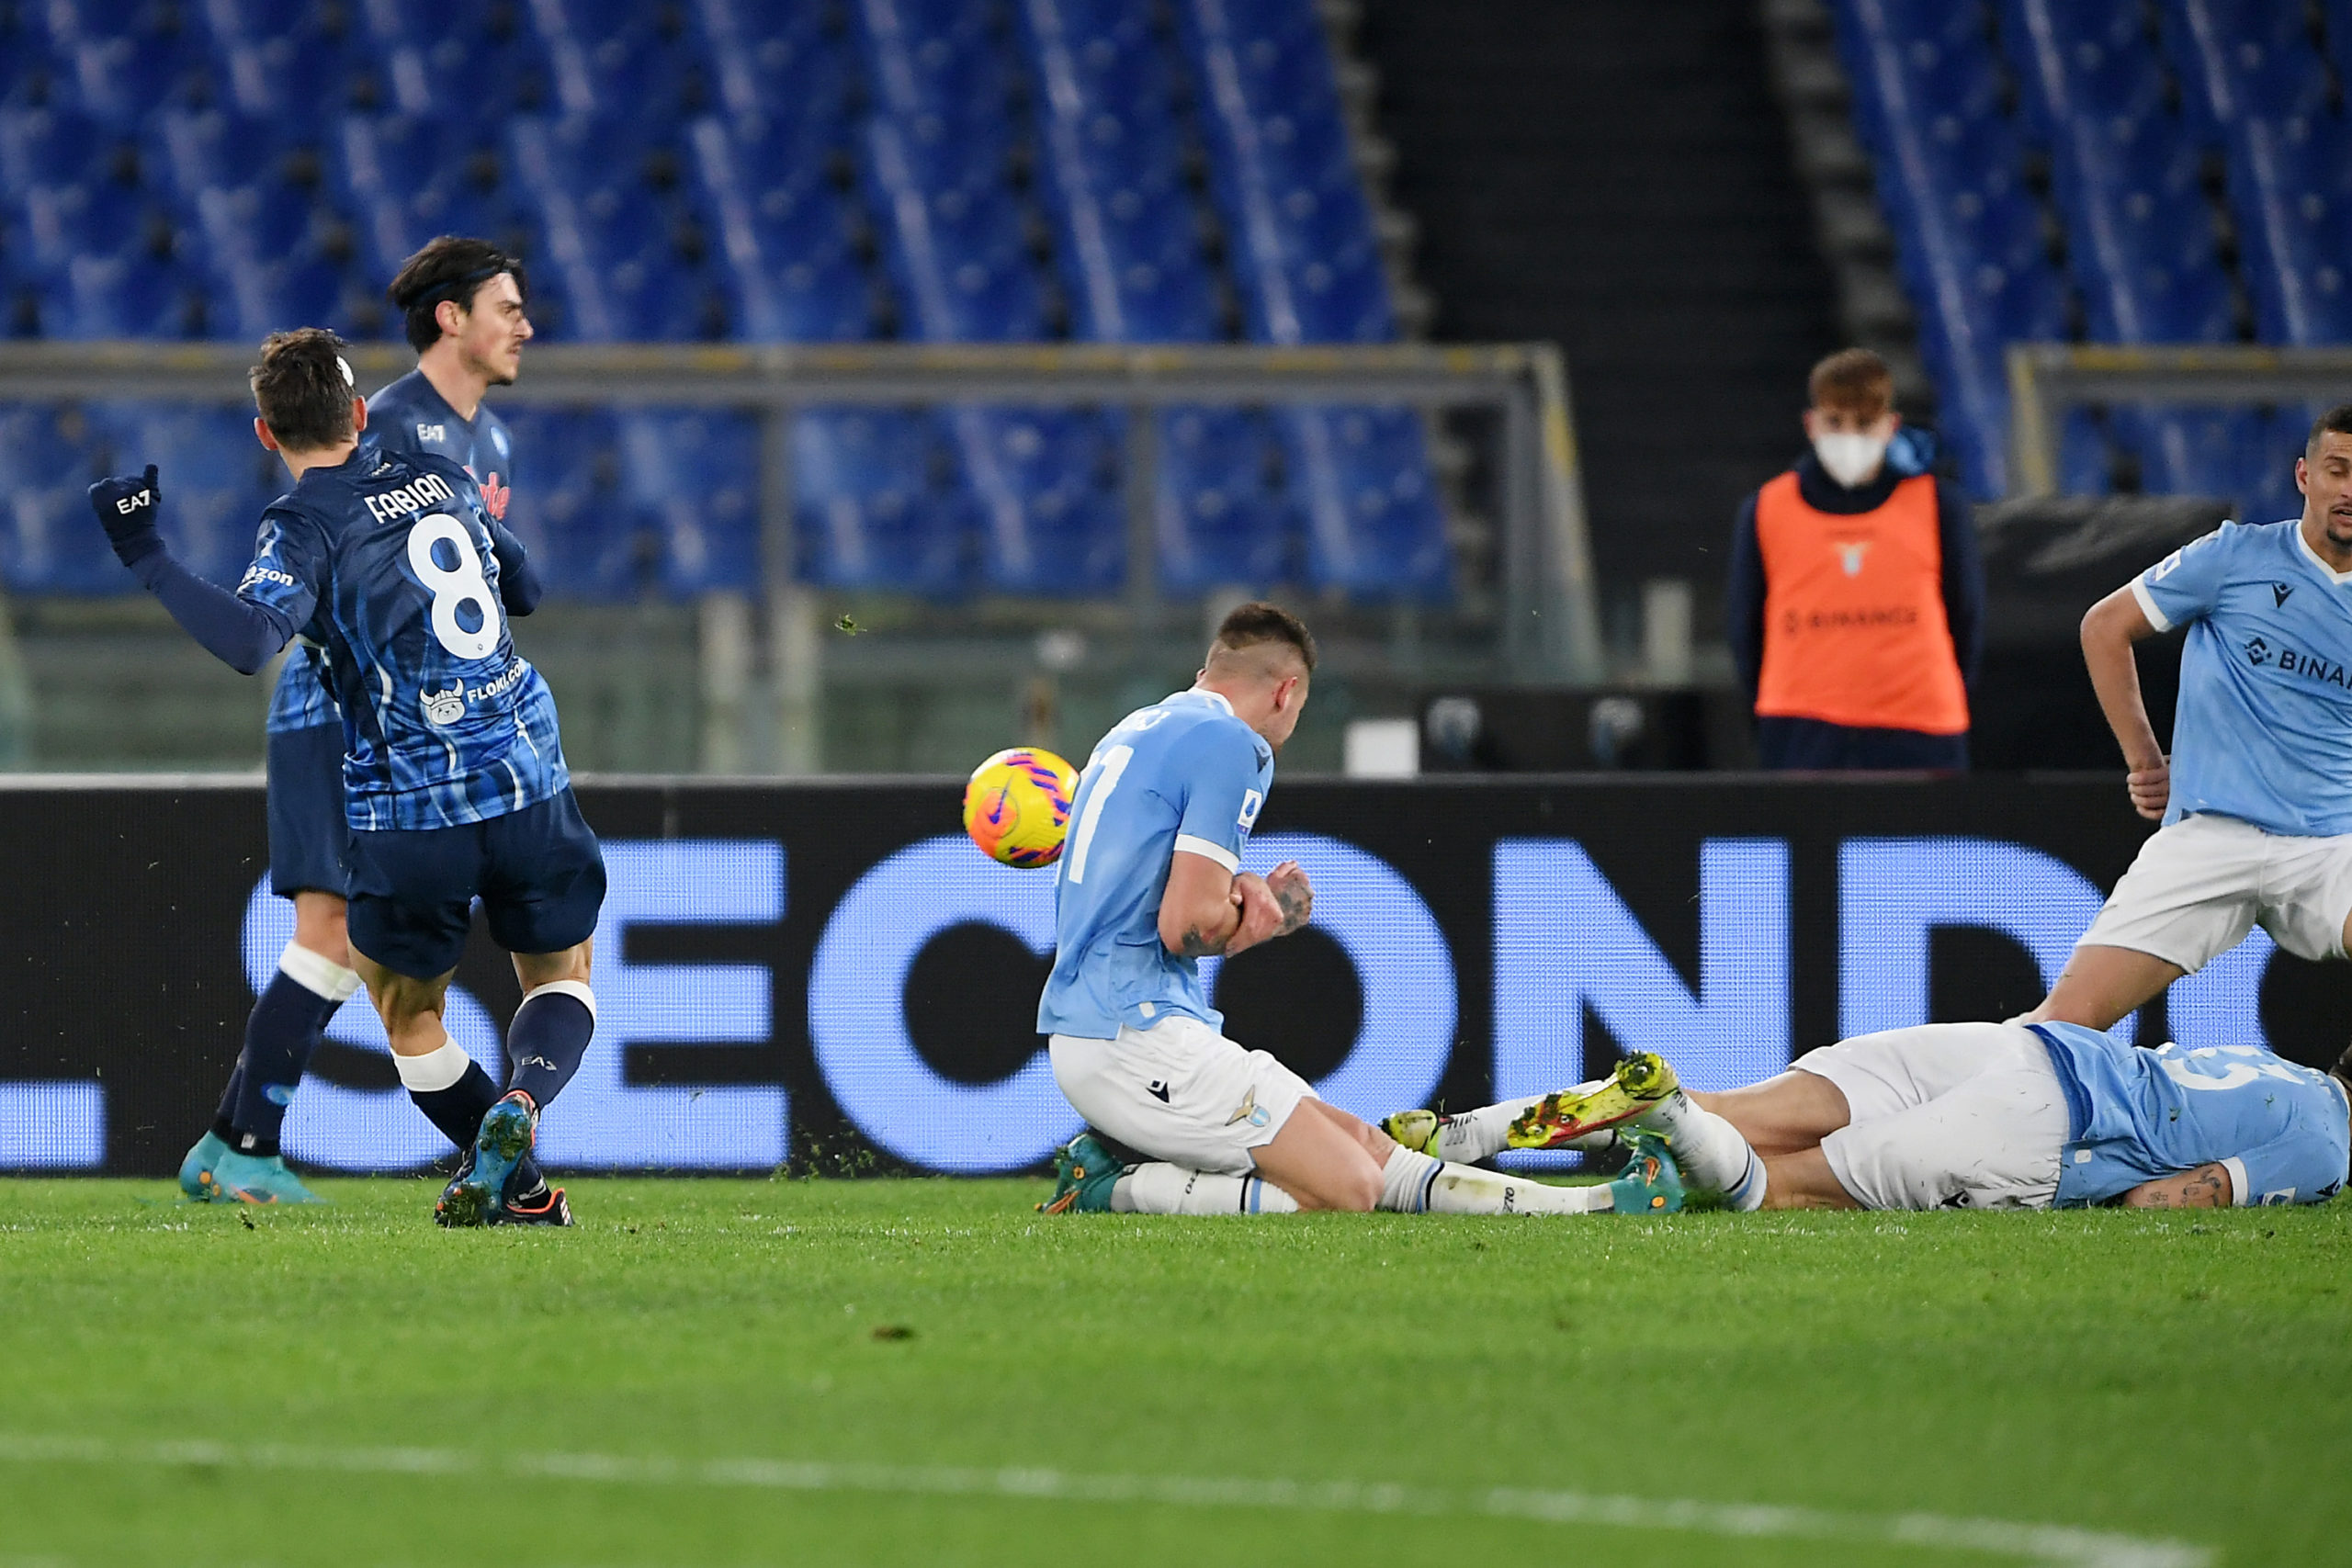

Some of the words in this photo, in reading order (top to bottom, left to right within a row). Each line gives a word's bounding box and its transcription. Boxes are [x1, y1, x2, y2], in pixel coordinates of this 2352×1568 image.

[116, 489, 151, 514] EA7
[364, 473, 456, 525] FABIAN
[407, 513, 500, 660] 8
[467, 663, 523, 704] FLOKI.CO
[243, 834, 2278, 1174] SECOND
